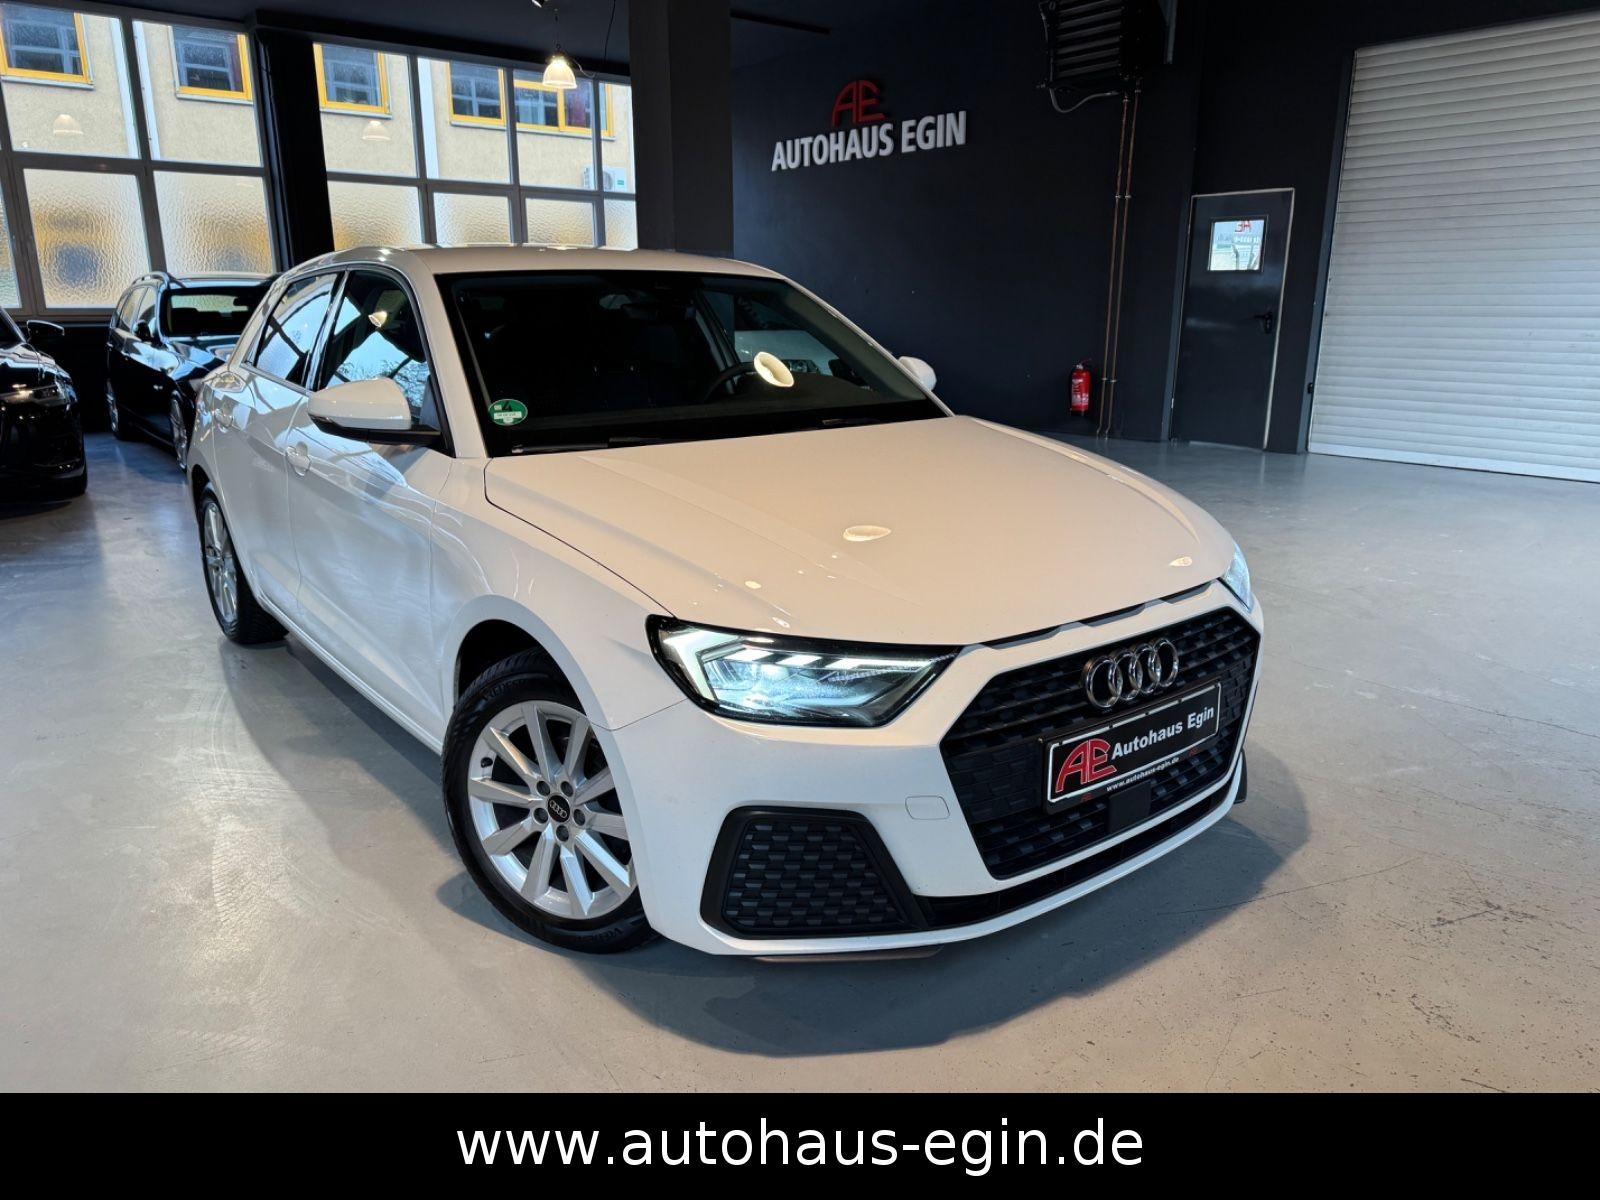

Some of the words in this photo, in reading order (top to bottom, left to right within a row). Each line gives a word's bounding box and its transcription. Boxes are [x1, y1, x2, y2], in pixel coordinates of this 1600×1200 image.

[831, 79, 886, 127] AE
[771, 122, 894, 172] AUTOHAUS
[901, 110, 967, 154] EGIN
[1055, 738, 1118, 793] AE
[1111, 721, 1184, 760] Autohaus
[1187, 706, 1214, 729] Egin
[1106, 756, 1180, 792] www.autohaus-egin.de
